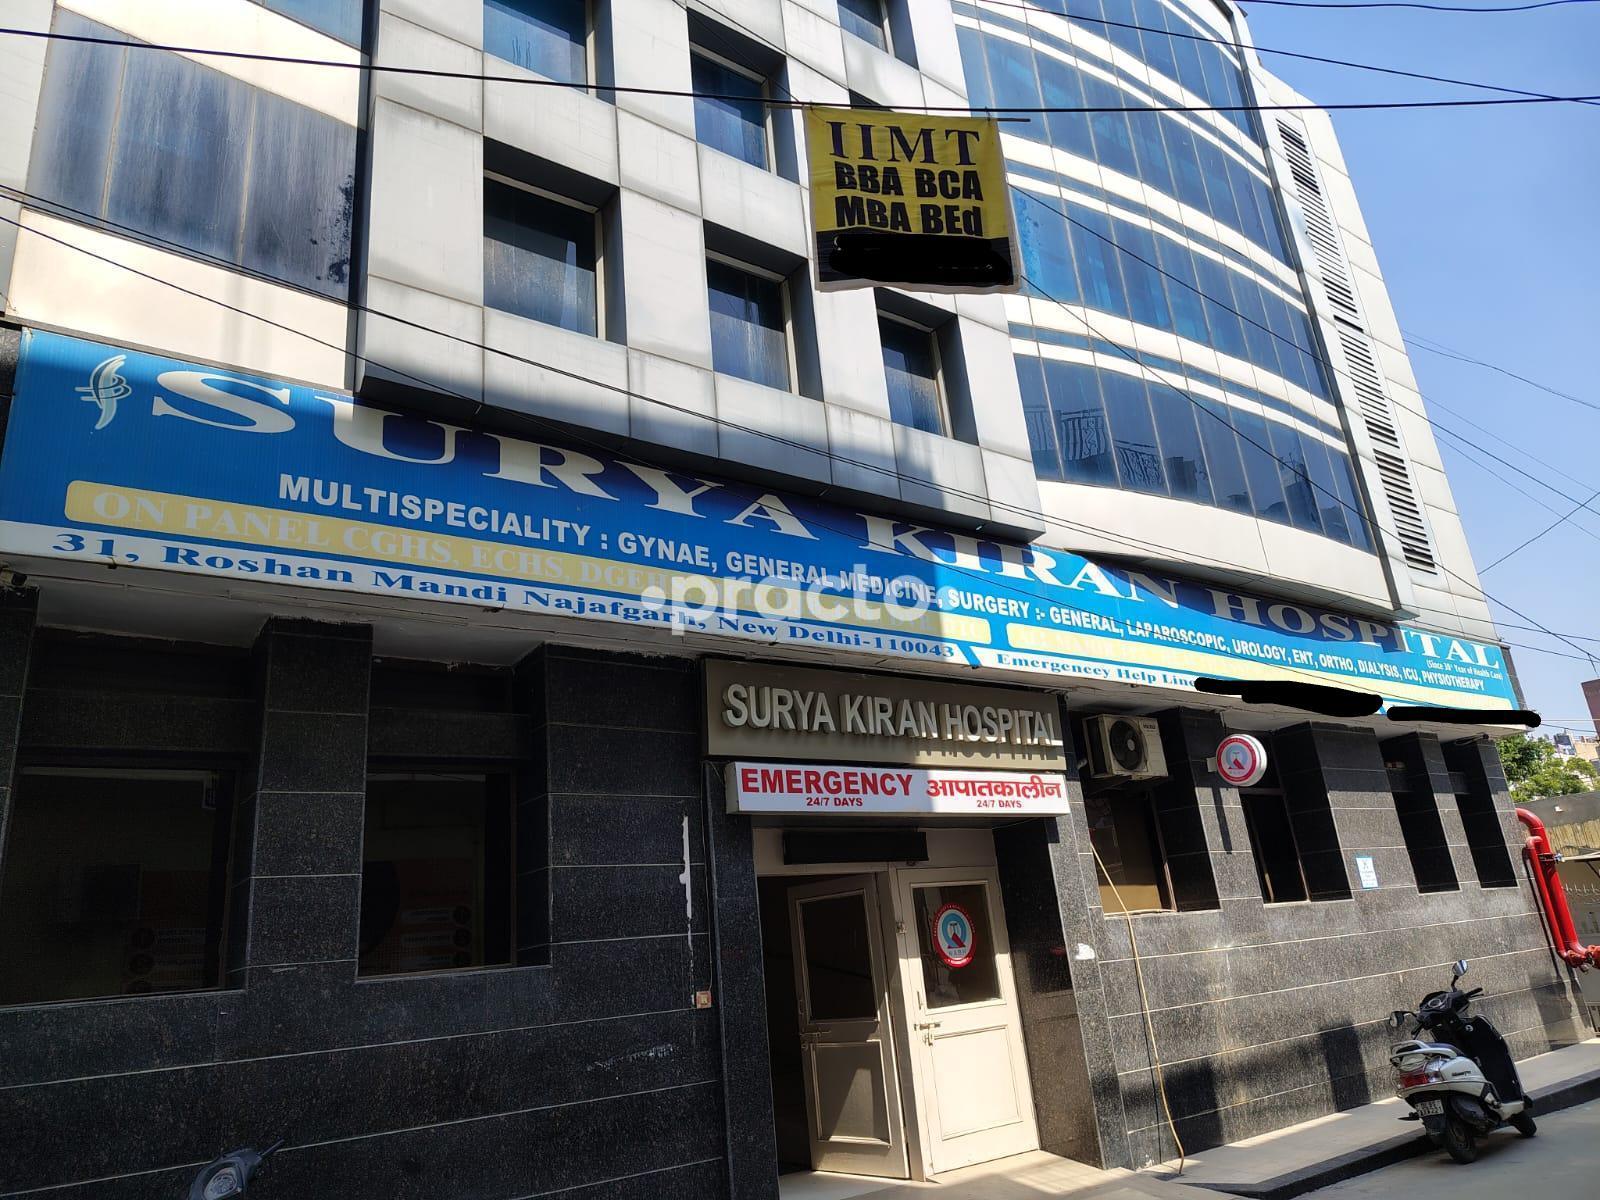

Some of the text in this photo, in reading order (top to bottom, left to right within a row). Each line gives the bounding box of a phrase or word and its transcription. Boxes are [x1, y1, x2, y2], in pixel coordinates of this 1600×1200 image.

[826, 121, 980, 166] IIMT
[834, 161, 984, 201] BBA BCA
[834, 196, 984, 237] MBA BEd
[93, 490, 177, 526] ON
[184, 503, 331, 548] PANEL
[343, 526, 460, 568] CGHS,
[151, 370, 820, 541] SURYA
[856, 512, 1181, 609] KIRAN
[1204, 587, 1499, 669] HOSPITAL
[51, 533, 140, 563] 31,
[161, 544, 354, 584] Roshan
[372, 570, 507, 602] Mandi
[522, 588, 706, 630] Najafgarh,
[718, 616, 778, 636] New
[789, 625, 955, 657] Delhi-110043
[279, 473, 592, 546] MULTISPECIALITY
[617, 531, 718, 573] GYNAE,
[727, 551, 833, 587] GENERAL
[839, 570, 943, 608] MEDICINE,
[948, 589, 1029, 620] SURGERY
[1051, 606, 1124, 638] GENERAL,
[1126, 617, 1231, 653] LAPAROSCOPIC,
[1231, 639, 1292, 664] UROLOGY,
[1293, 649, 1318, 669] ENT,
[1319, 653, 1357, 674] ORTHO,
[1358, 660, 1402, 680] DIALYSIS,
[1402, 667, 1421, 684] ICU,
[1422, 670, 1485, 691] PHYSIOTHERAPY
[1117, 668, 1157, 688] Help
[722, 684, 1055, 748] SURYA KIRAN HOSPITAL
[741, 767, 913, 797] EMERGENCY
[806, 796, 864, 807] 24/7 DAYS
[925, 775, 1062, 800] आपातकालीन
[976, 798, 1022, 809] 24/7 DAYS
